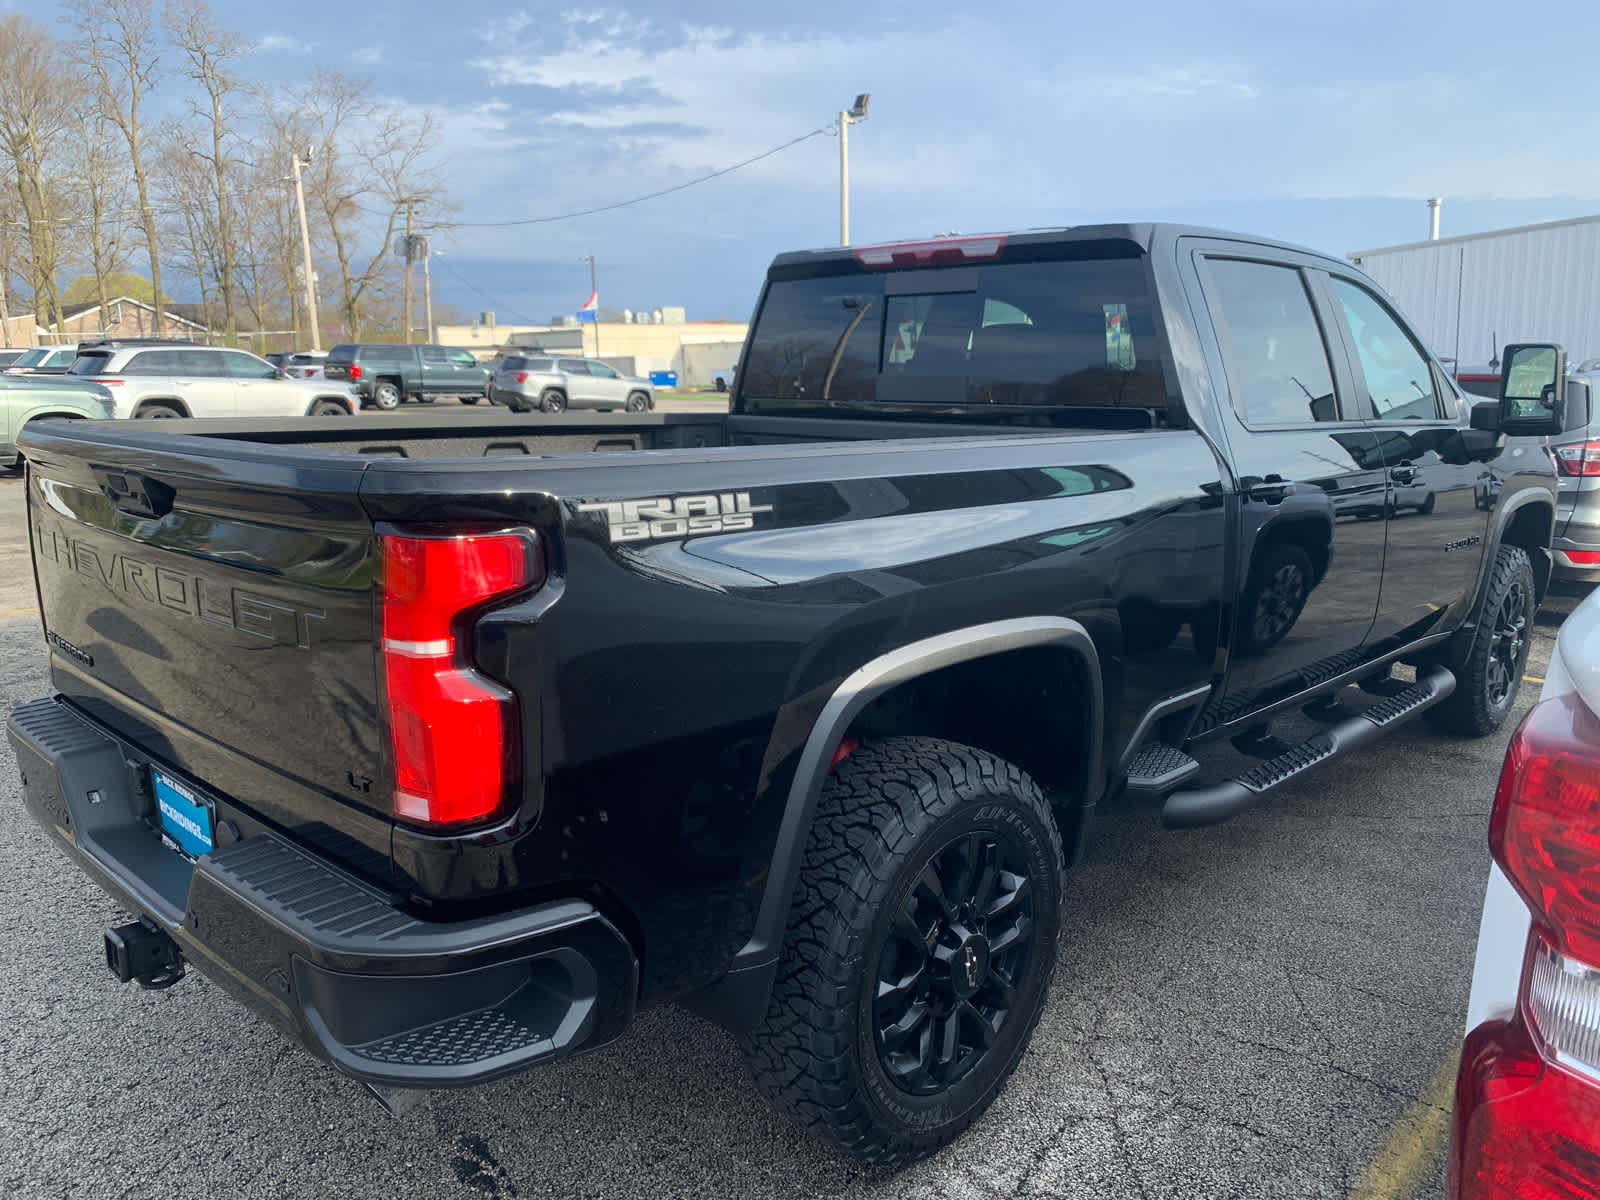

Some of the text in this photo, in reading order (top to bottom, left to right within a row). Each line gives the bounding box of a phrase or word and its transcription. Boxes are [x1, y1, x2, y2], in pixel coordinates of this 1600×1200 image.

[577, 492, 773, 523] TRAIL
[610, 513, 754, 543] BOSS
[36, 524, 327, 649] CHEVROLET
[344, 770, 374, 792] LT
